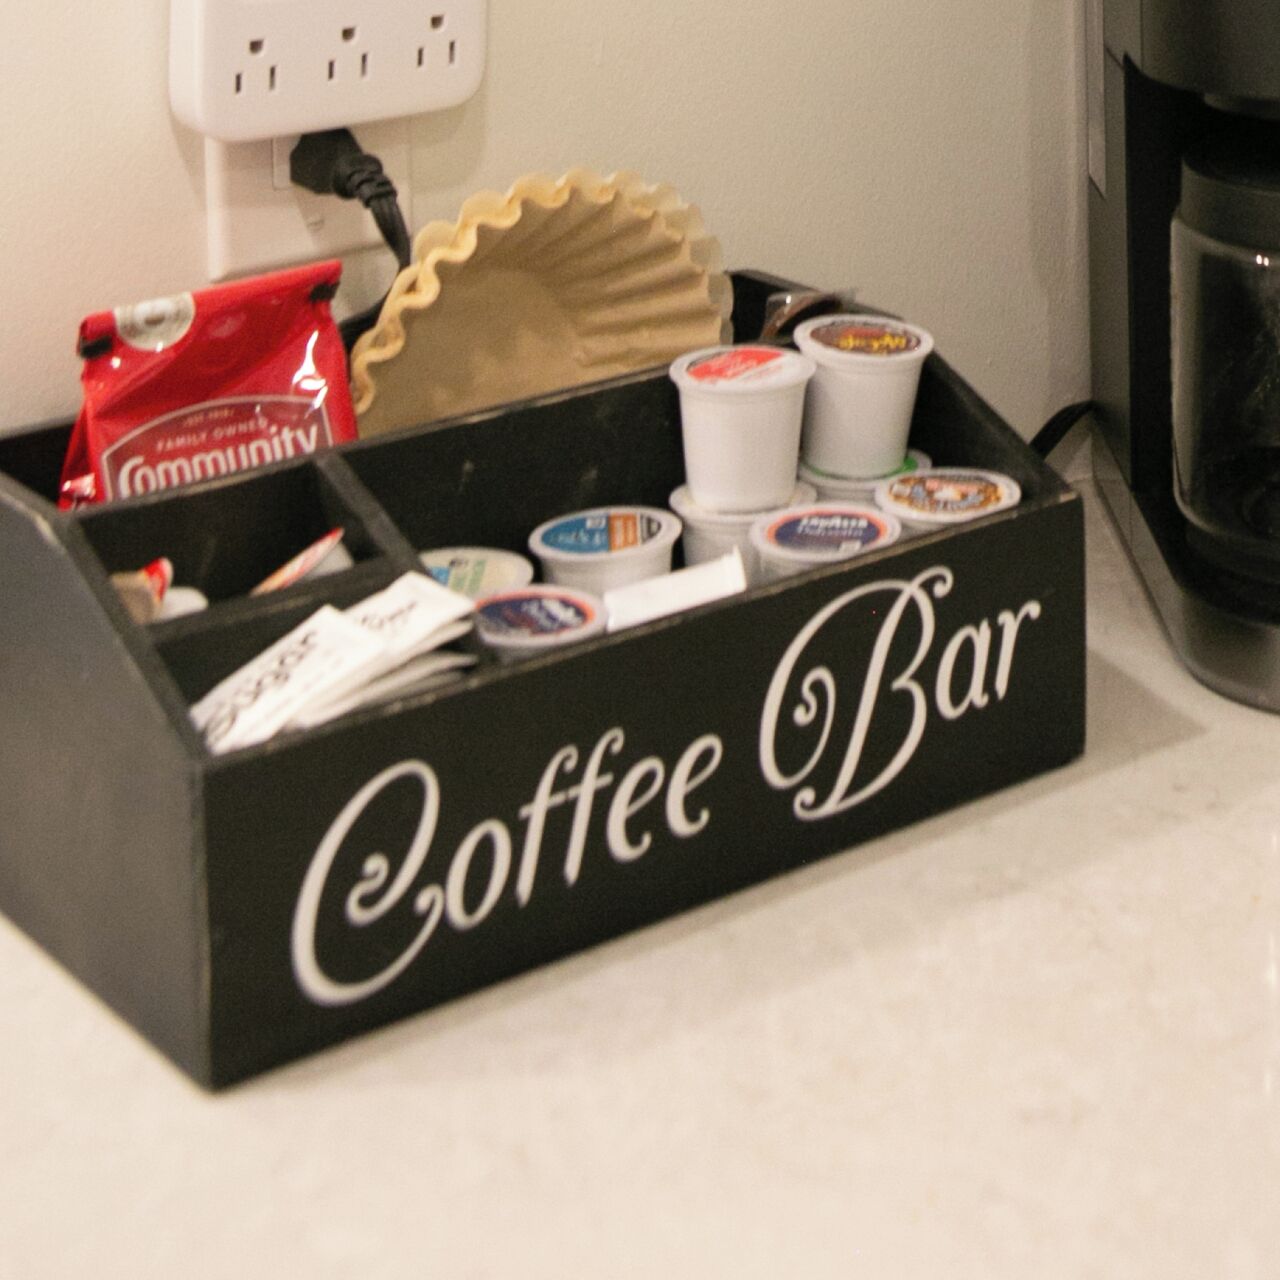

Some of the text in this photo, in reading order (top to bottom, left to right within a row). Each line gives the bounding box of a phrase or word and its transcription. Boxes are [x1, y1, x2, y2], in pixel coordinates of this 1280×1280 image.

[118, 424, 319, 499] Community
[155, 430, 208, 453] FAMILY
[212, 416, 269, 439] OWNED
[290, 565, 1041, 1006] Coffee Bar
